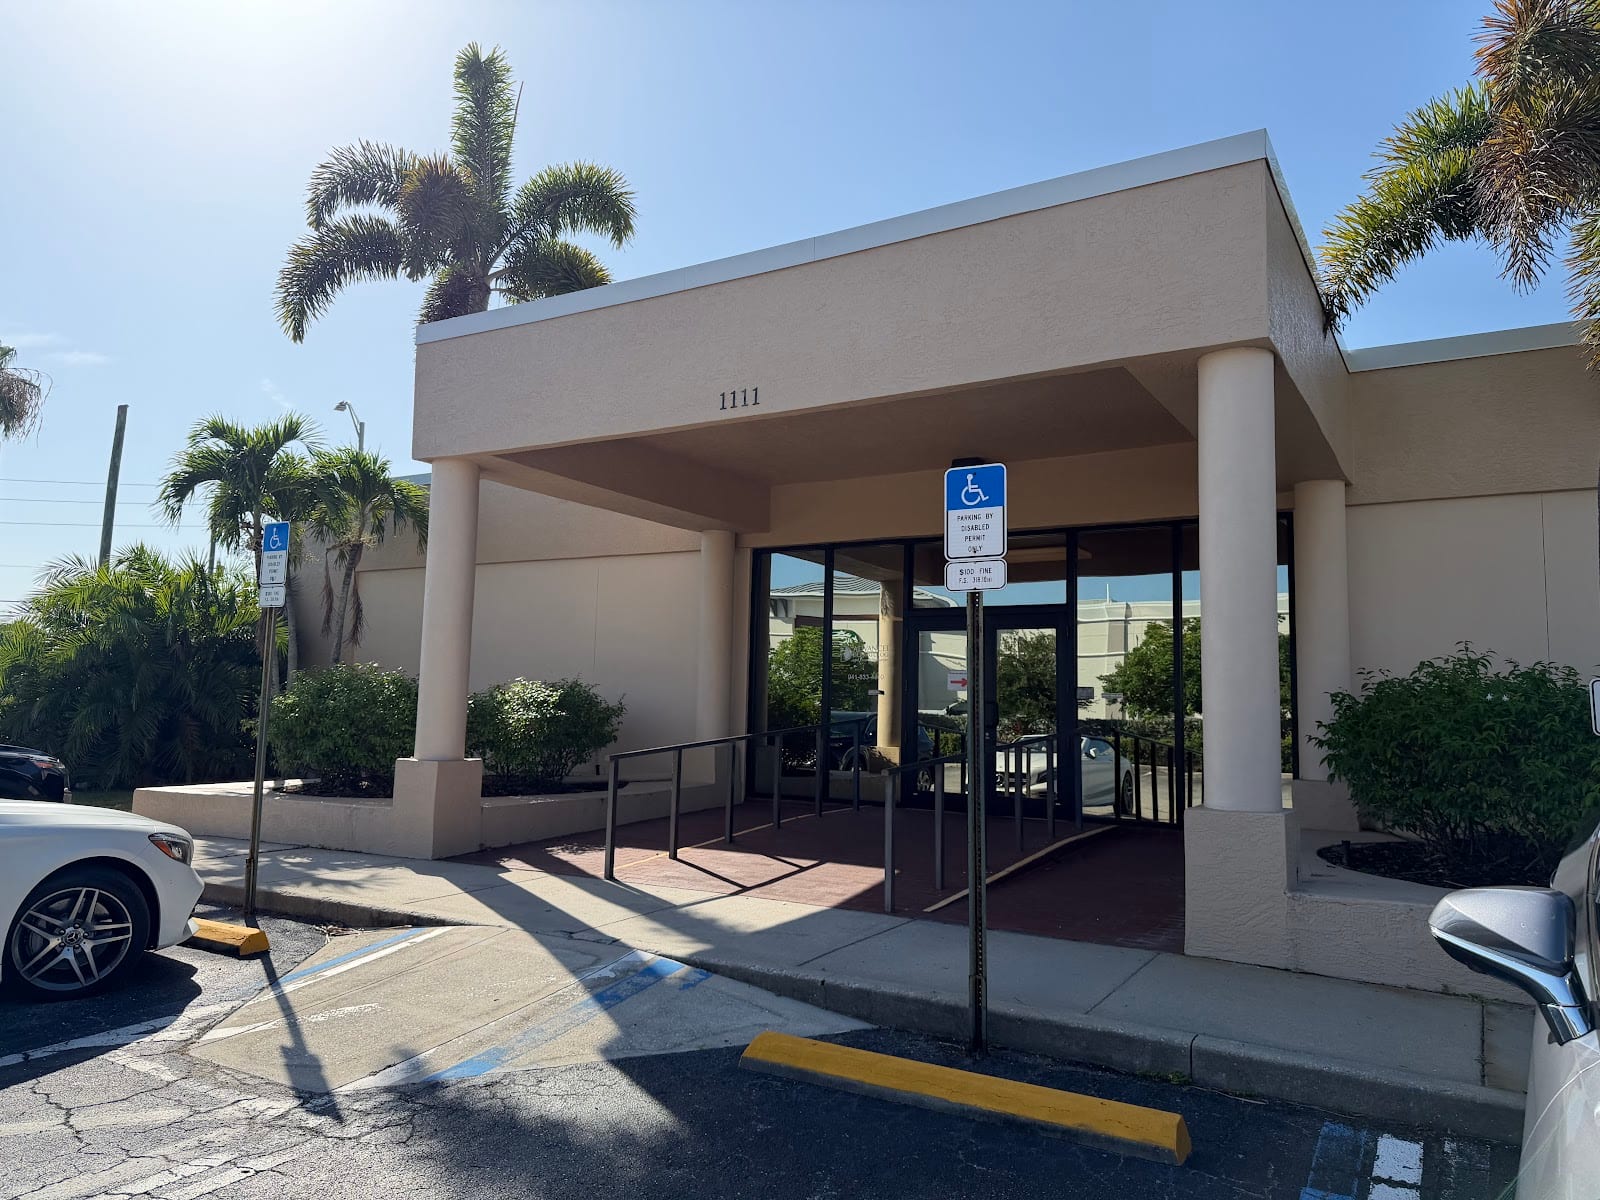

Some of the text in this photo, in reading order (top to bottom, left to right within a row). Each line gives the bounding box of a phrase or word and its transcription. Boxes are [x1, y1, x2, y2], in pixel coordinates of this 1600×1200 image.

[720, 387, 760, 410] 1111
[956, 512, 994, 522] PARKING BY
[961, 523, 990, 532] DISABLED
[964, 534, 986, 542] PERMIT
[967, 545, 983, 553] ONLY
[959, 568, 975, 576] $100
